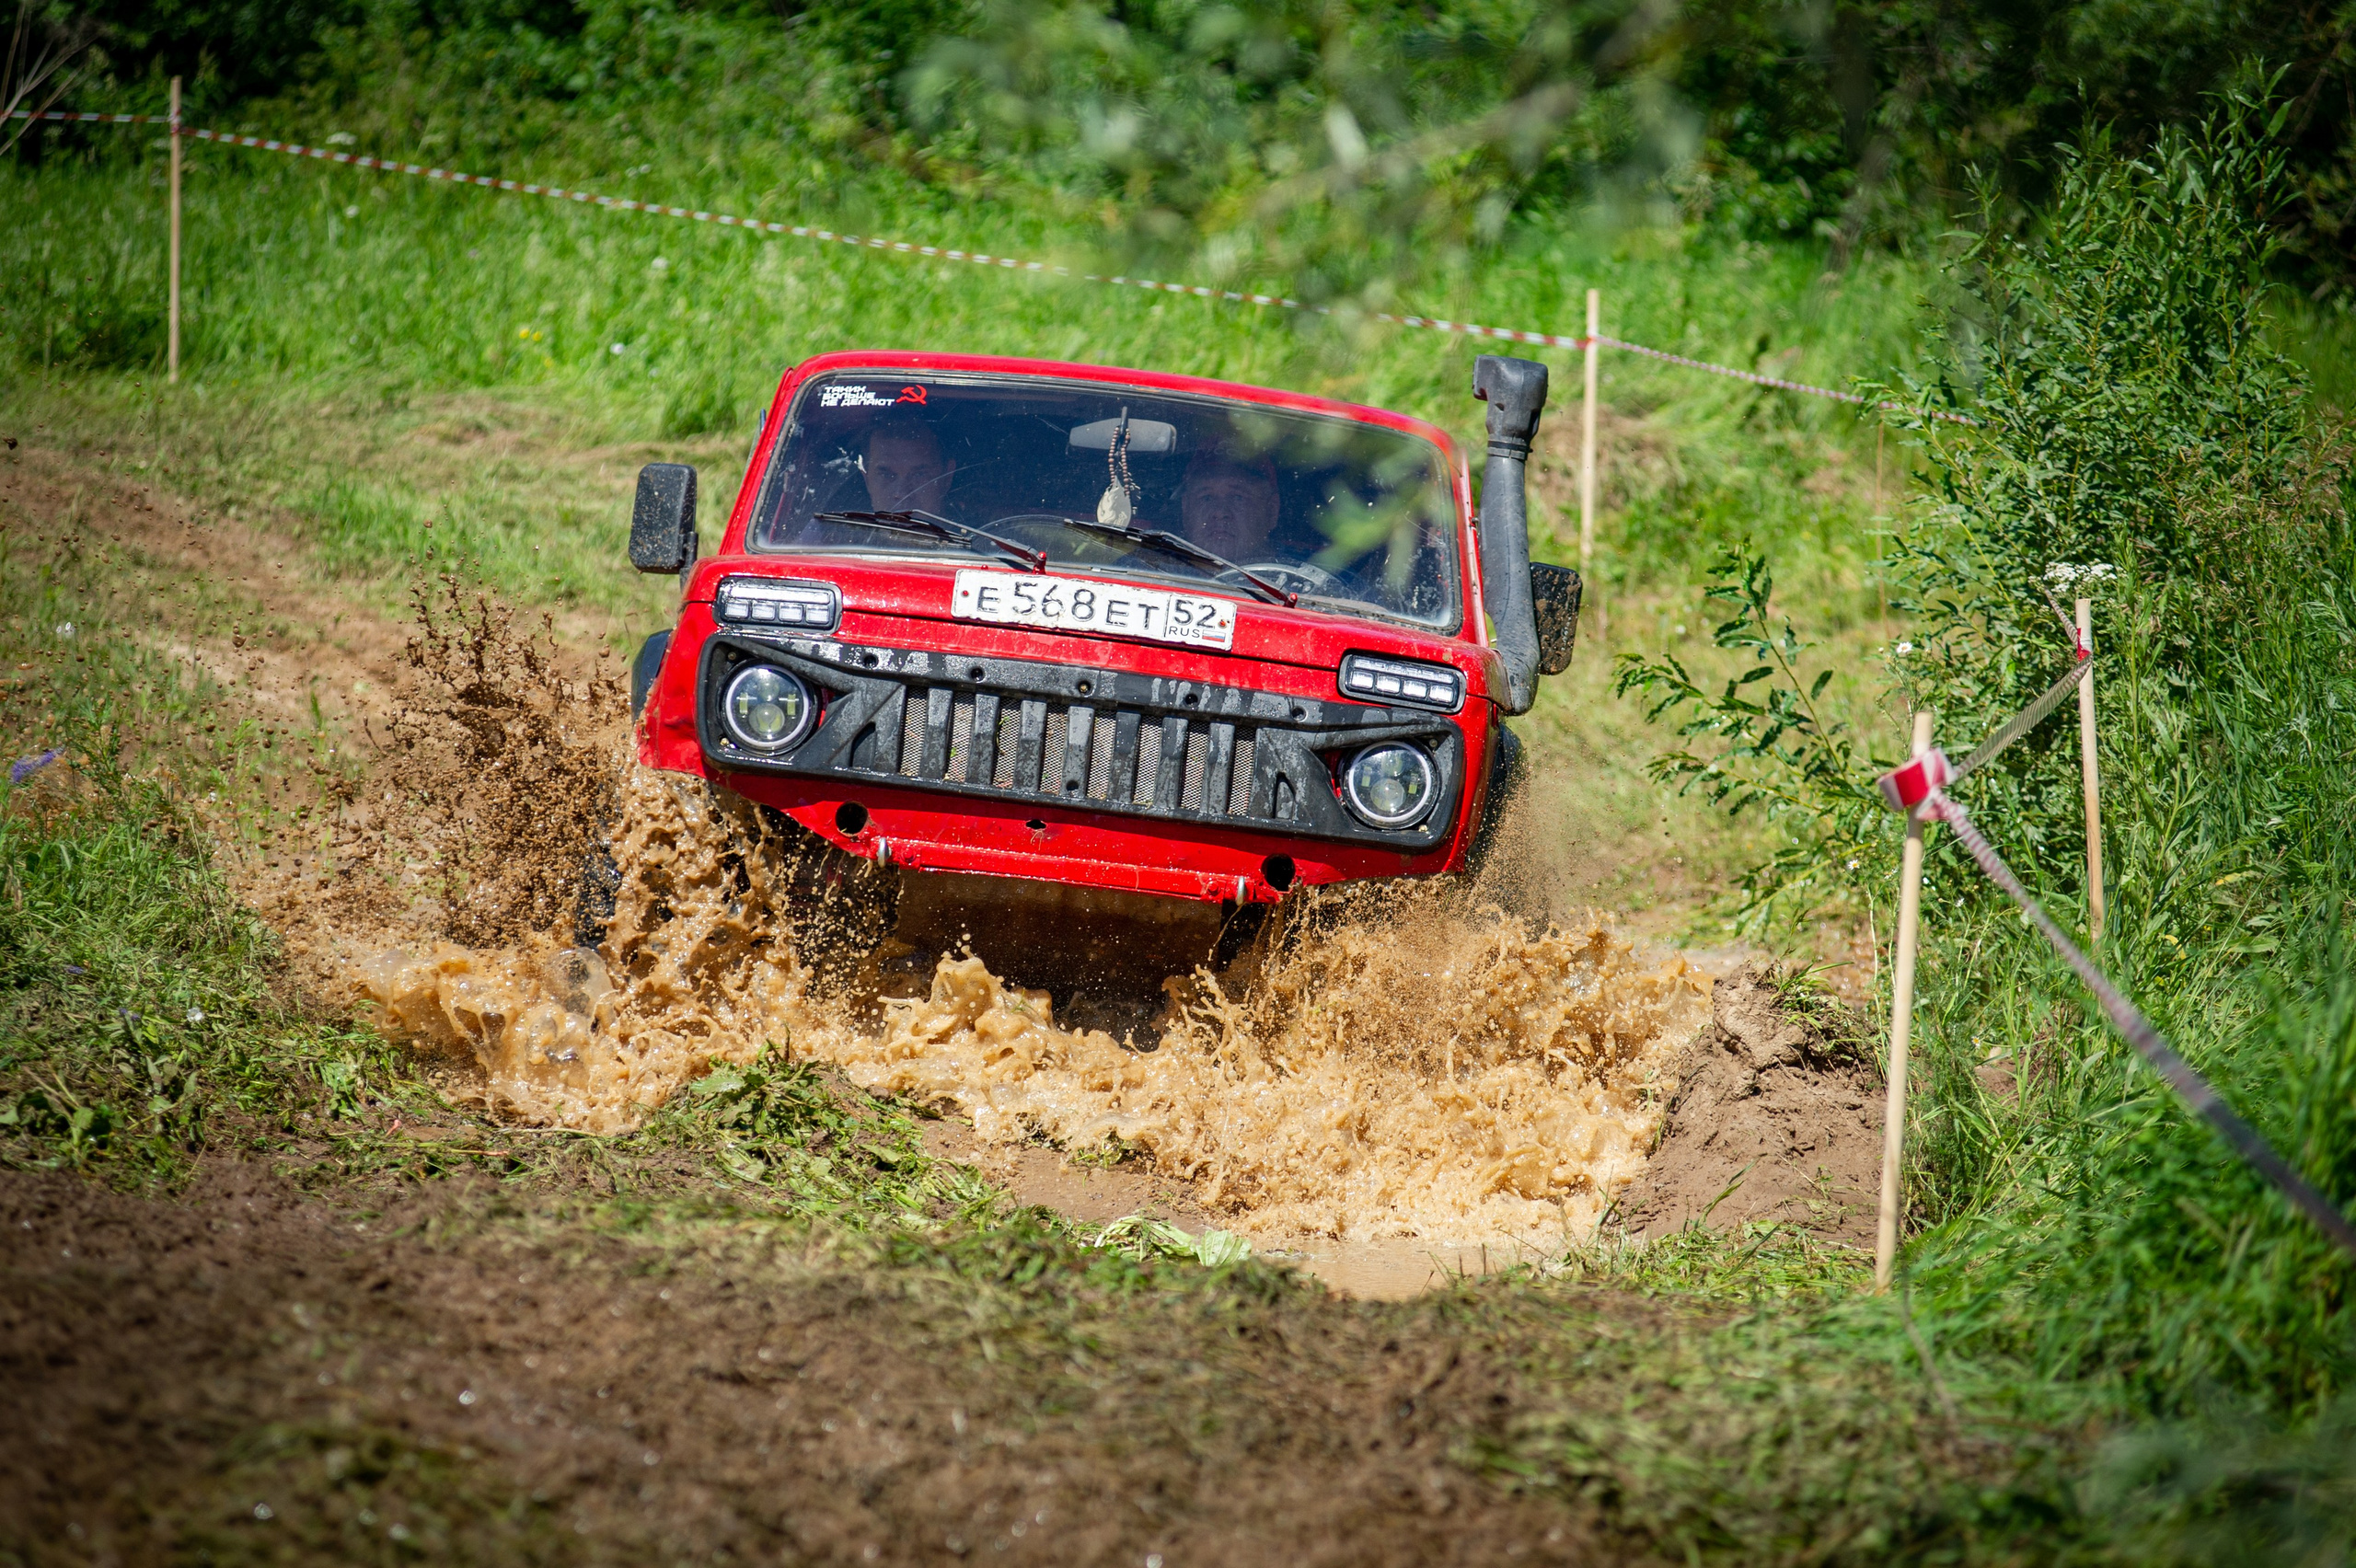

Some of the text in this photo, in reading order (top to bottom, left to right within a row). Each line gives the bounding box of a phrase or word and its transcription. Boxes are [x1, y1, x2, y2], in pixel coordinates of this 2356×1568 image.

[821, 398, 895, 407] НЕ ДЕЛАЮТ
[1173, 599, 1217, 629] 52
[1168, 626, 1201, 639] RUS
